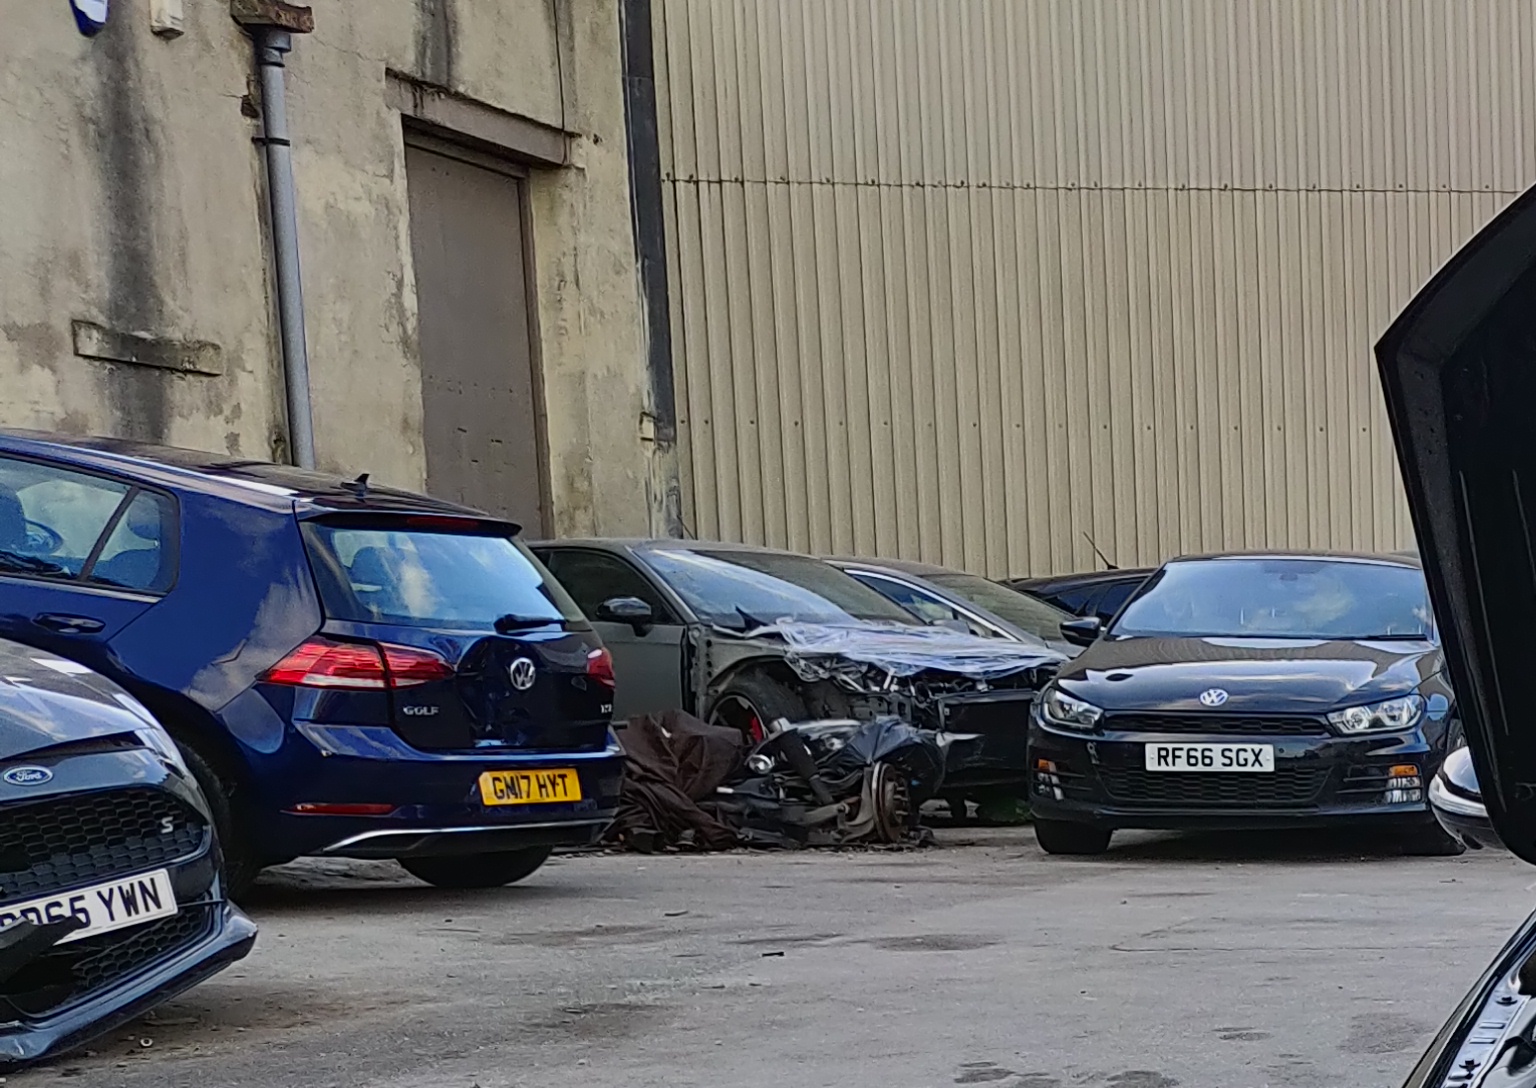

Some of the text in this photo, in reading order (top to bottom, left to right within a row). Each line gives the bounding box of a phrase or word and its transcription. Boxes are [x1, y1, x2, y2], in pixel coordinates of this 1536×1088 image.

[403, 705, 440, 716] GOLF
[1156, 746, 1264, 768] RF66 SGX
[492, 774, 568, 800] GM17 HYT
[160, 816, 174, 834] S
[96, 877, 163, 922] YWN
